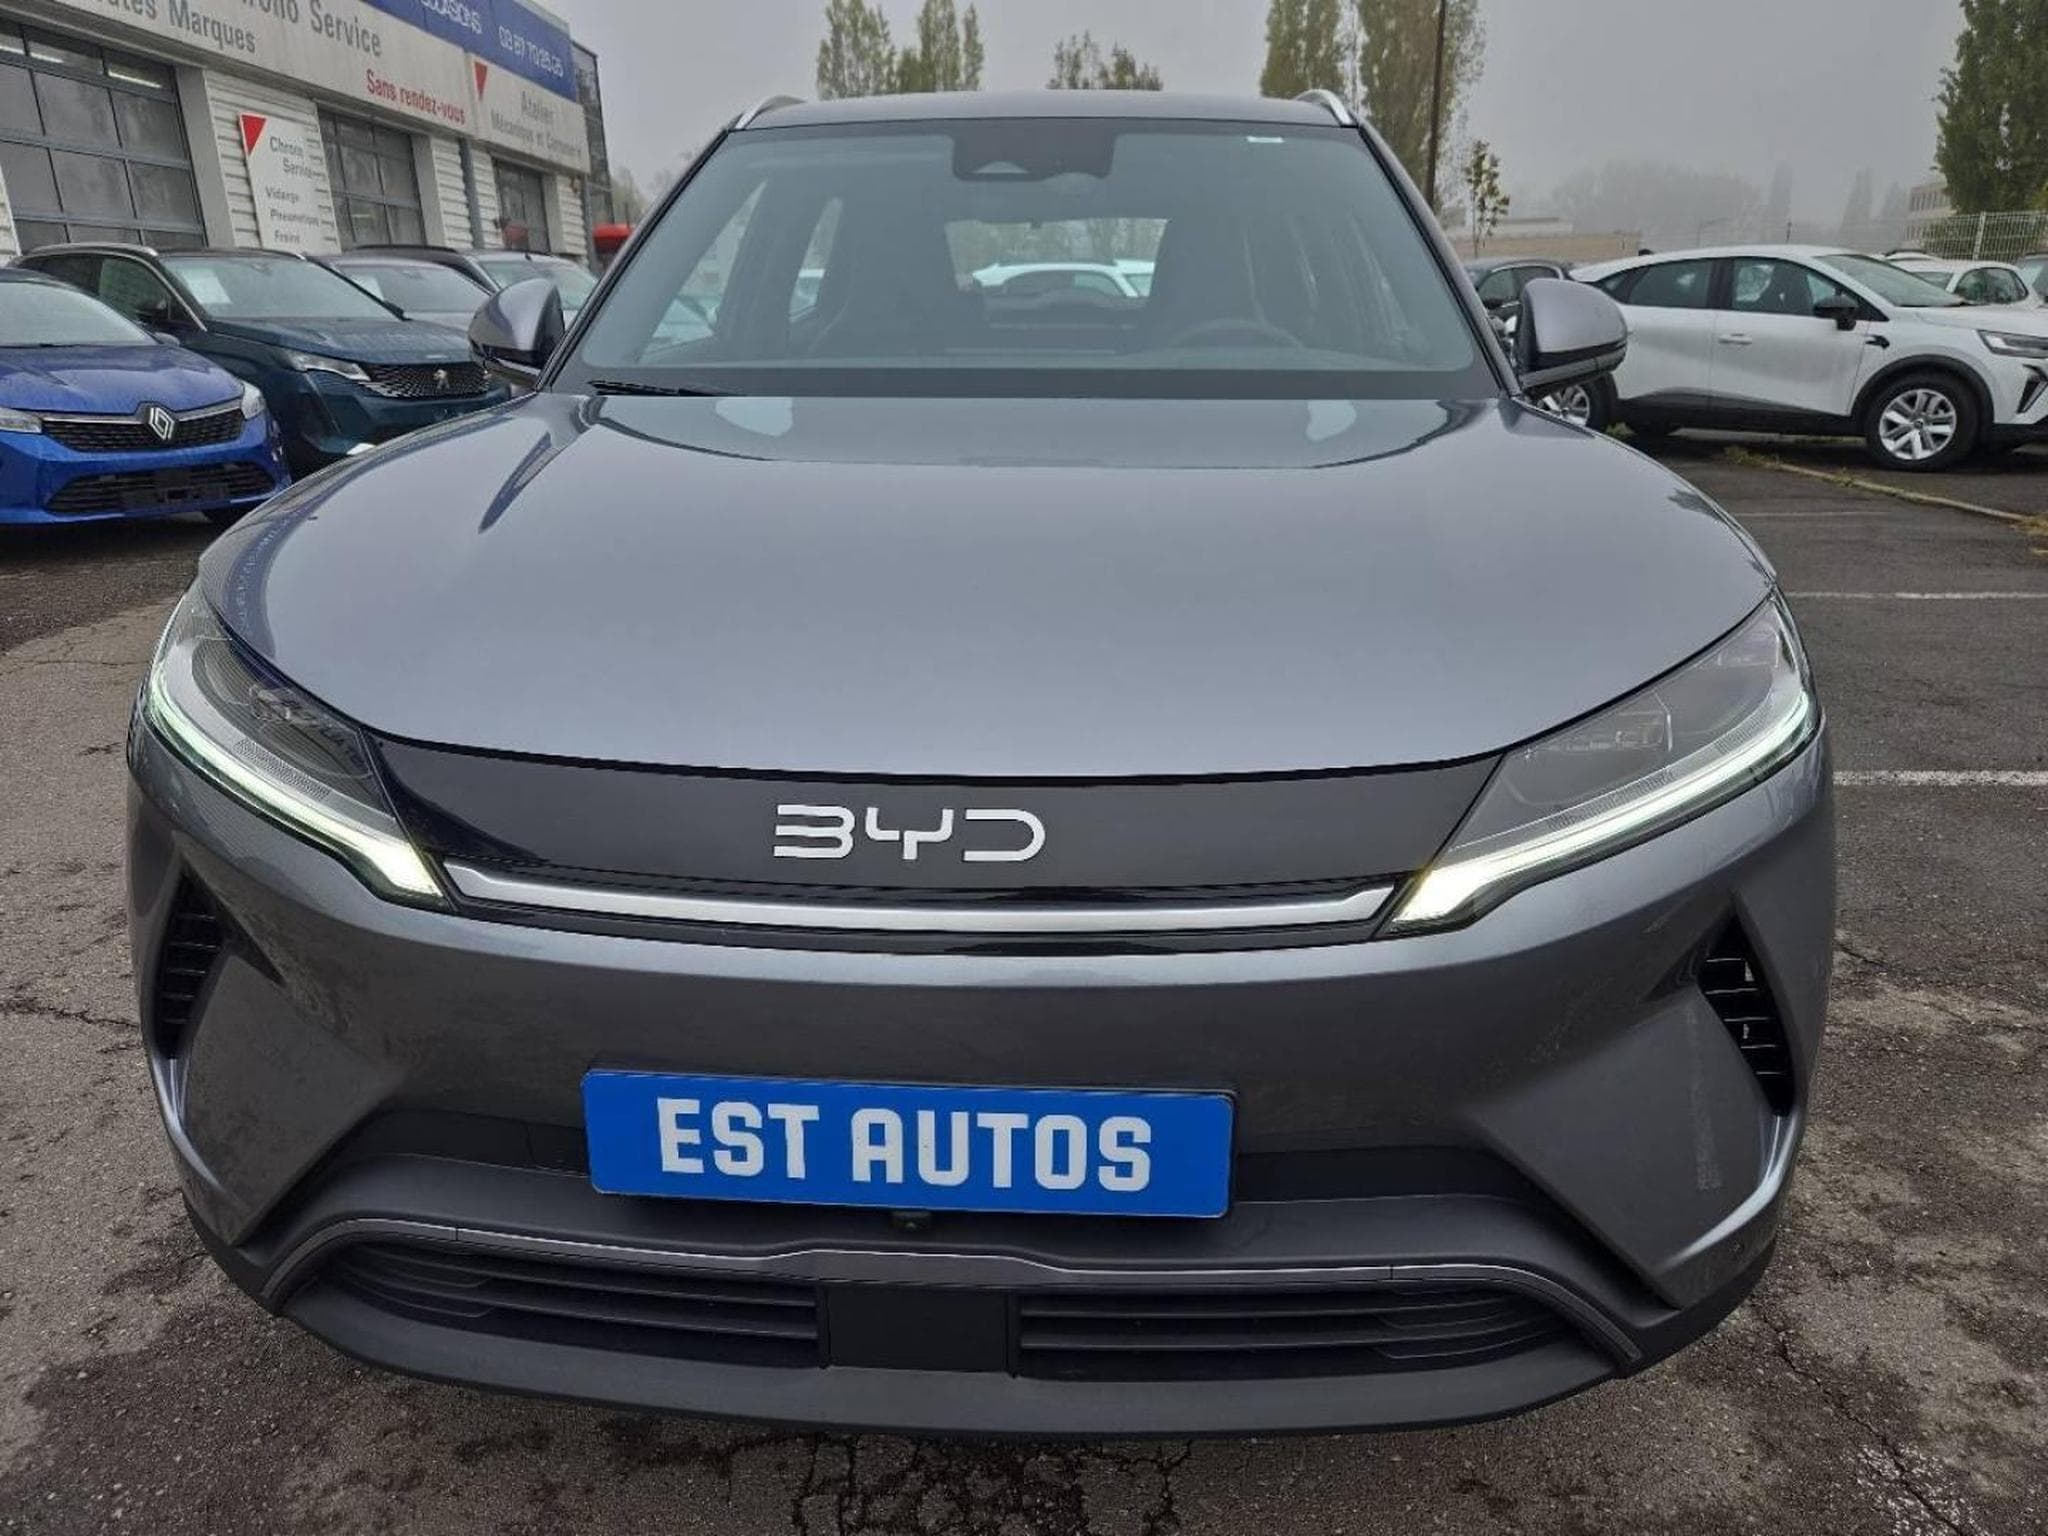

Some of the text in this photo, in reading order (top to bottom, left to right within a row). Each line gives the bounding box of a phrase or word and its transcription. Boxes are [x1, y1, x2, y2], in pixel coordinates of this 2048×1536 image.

[169, 0, 256, 53] Marques
[310, 0, 382, 56] Service
[366, 68, 397, 101] Sans
[774, 804, 1045, 861] BYD
[657, 1097, 1152, 1192] EST AUTOS
